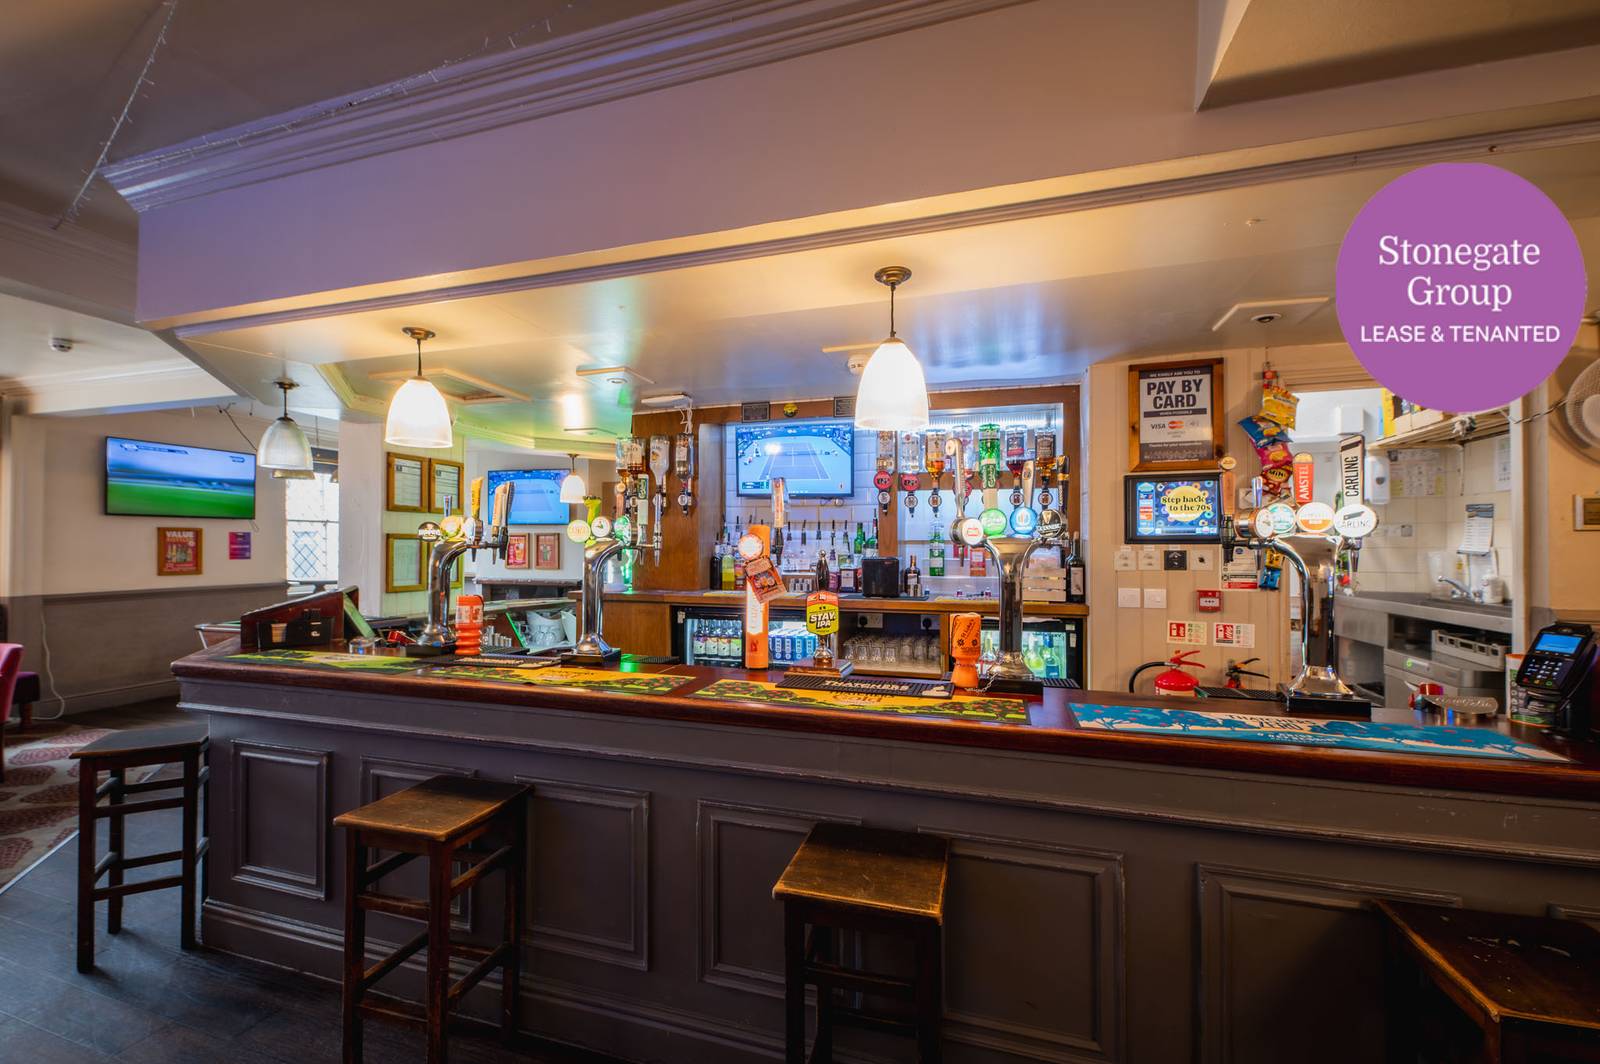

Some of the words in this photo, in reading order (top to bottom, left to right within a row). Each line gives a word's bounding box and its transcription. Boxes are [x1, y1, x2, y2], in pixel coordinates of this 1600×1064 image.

[1147, 380, 1176, 395] PAY
[1181, 379, 1203, 393] BY
[1152, 394, 1197, 410] CARD
[1299, 465, 1309, 499] AMSTEL
[1344, 456, 1360, 497] CARLING
[1162, 496, 1181, 504] Step
[1183, 495, 1204, 503] back
[817, 620, 831, 629] IPA
[823, 680, 910, 691] THATCHERS
